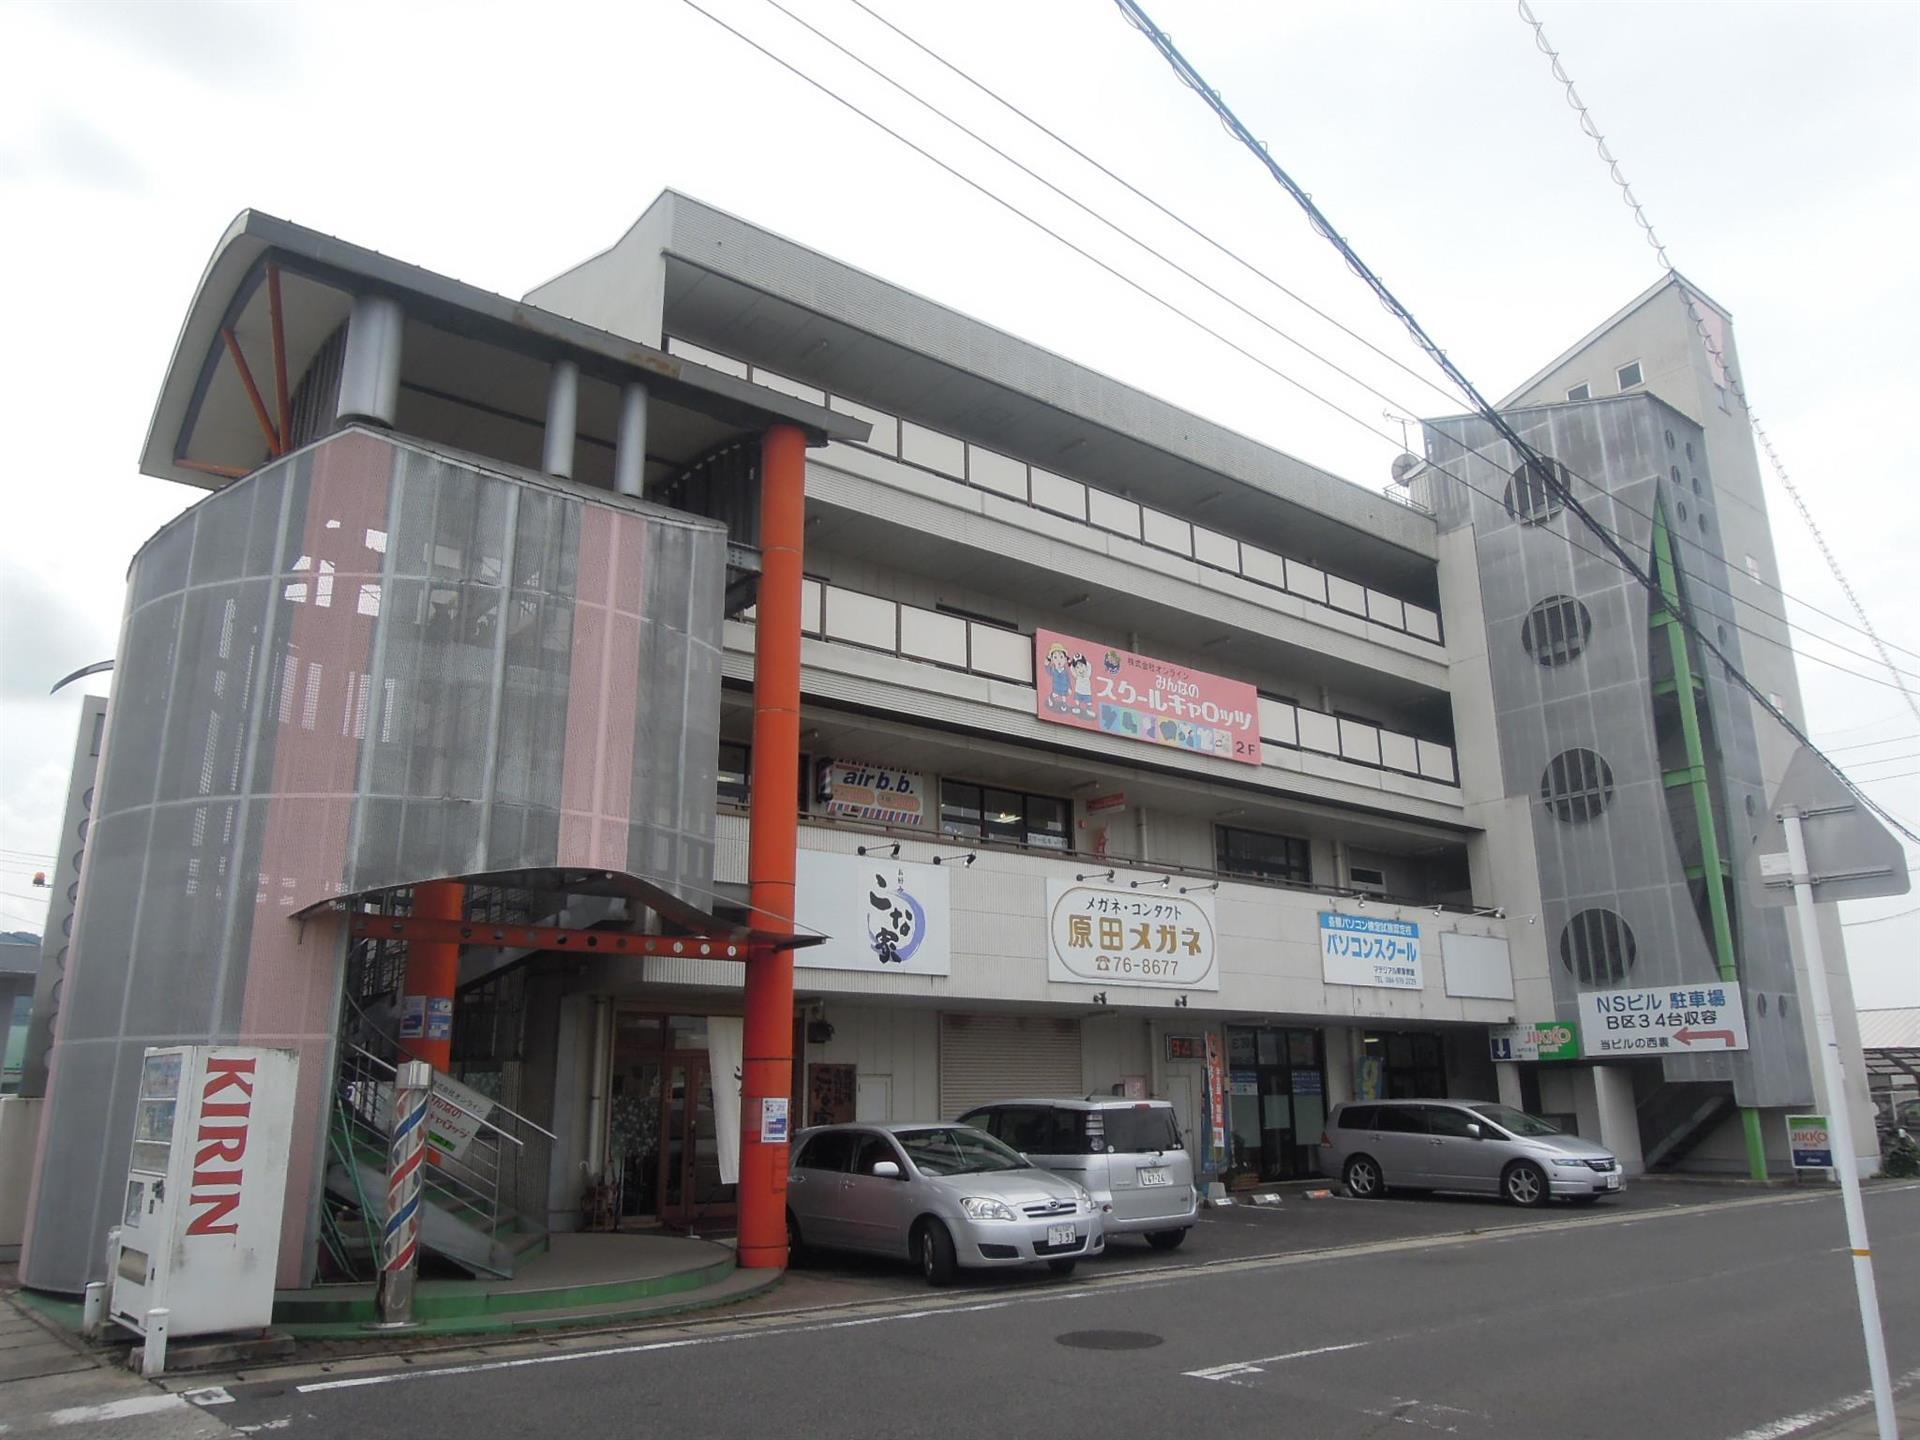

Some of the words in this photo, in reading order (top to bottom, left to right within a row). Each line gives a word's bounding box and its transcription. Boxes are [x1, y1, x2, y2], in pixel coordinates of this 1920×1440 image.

[1155, 674, 1200, 698] みんなの
[1096, 676, 1252, 730] スクールキャロッツ
[1086, 897, 1182, 920] メガネ・コンタクト
[1068, 914, 1202, 956] 原田メガネ
[1327, 933, 1417, 963] パソコンスクール
[1113, 956, 1179, 976] 76-8677
[1597, 993, 1662, 1013] NSビル
[1669, 989, 1726, 1009] 駐車場
[1524, 1025, 1571, 1046] JIKKO
[1600, 1037, 1669, 1050] 当ビルの西裏
[186, 1056, 257, 1236] KIRIN
[1792, 1131, 1828, 1144] JIKKO
